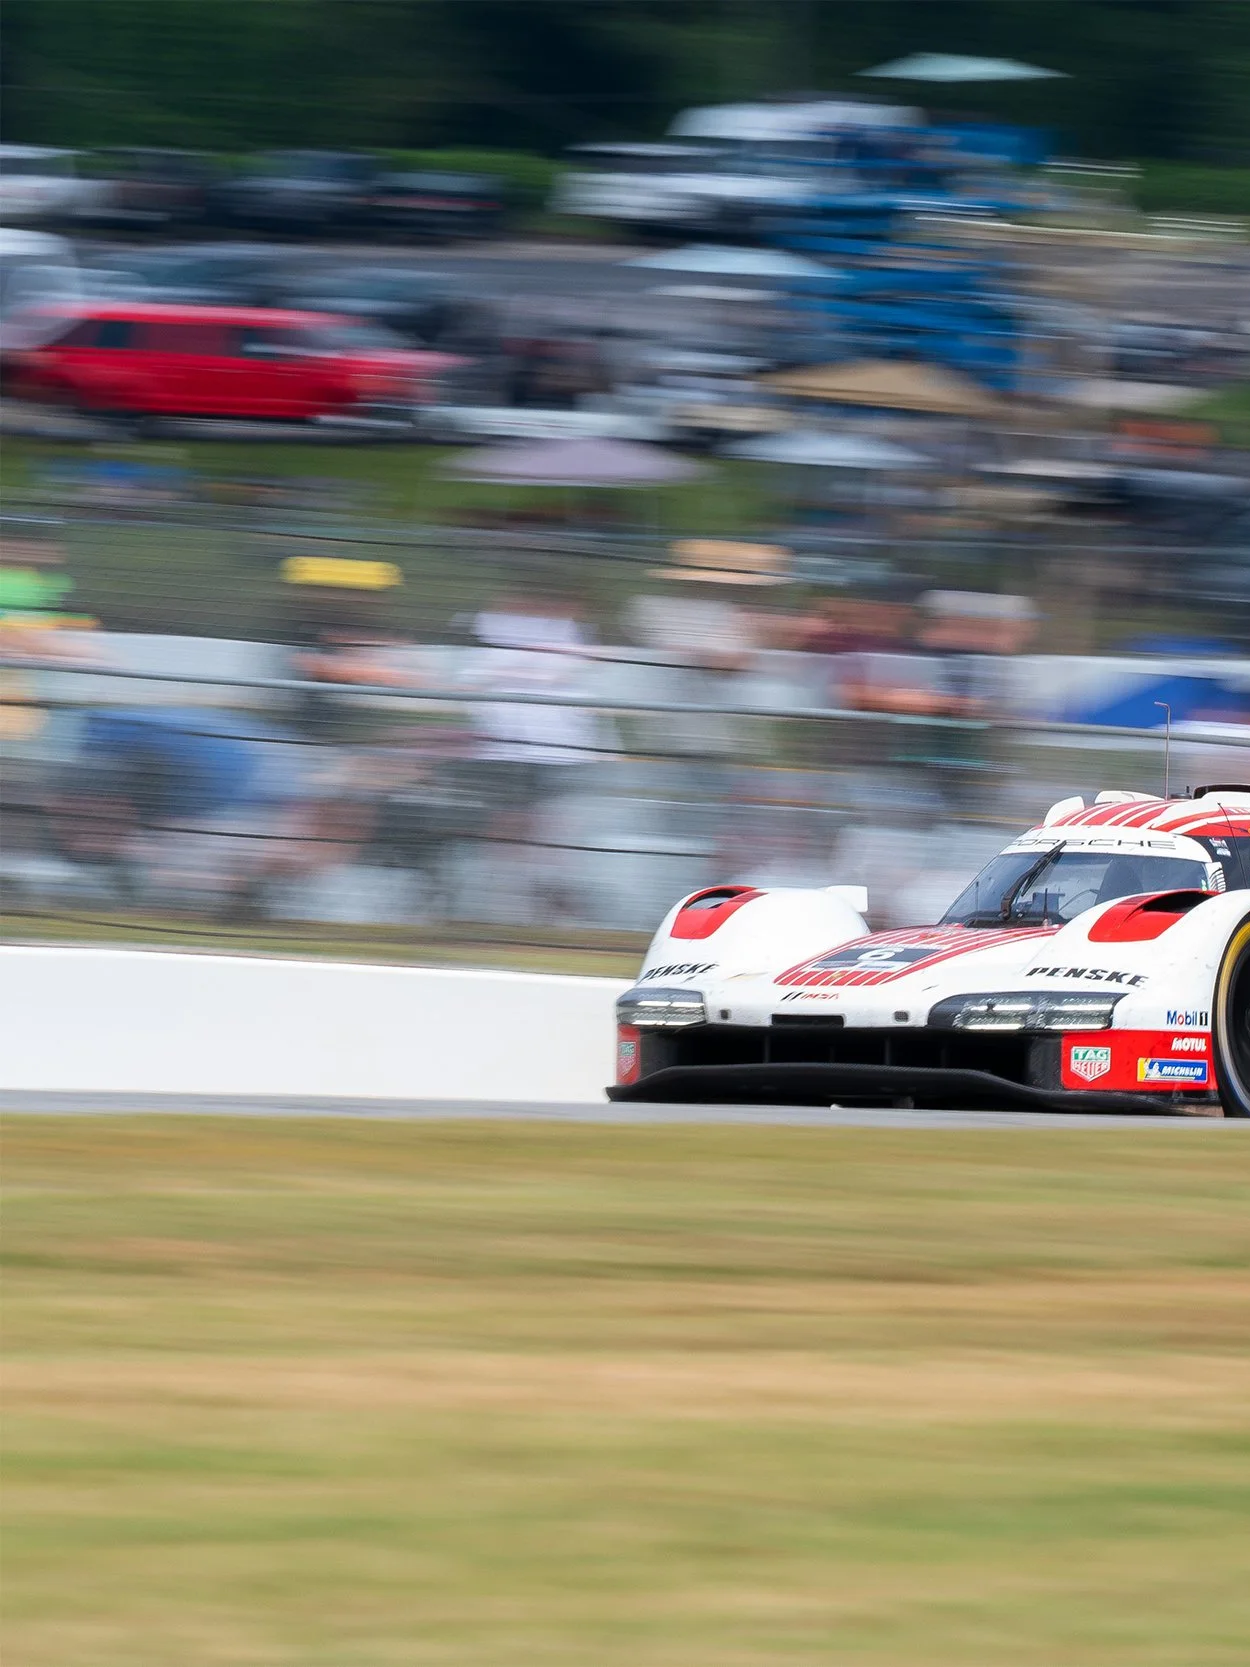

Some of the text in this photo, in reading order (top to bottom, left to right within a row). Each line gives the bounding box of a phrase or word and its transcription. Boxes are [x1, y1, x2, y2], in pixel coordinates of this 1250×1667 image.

[635, 963, 720, 986] PENSKE
[1025, 966, 1149, 989] PENSKE
[1166, 1010, 1209, 1026] Mobil 1
[1171, 1037, 1207, 1052] MOTUL
[1075, 1048, 1108, 1060] TAG
[1073, 1060, 1109, 1079] HEUER
[1161, 1065, 1203, 1077] MICHELIN
